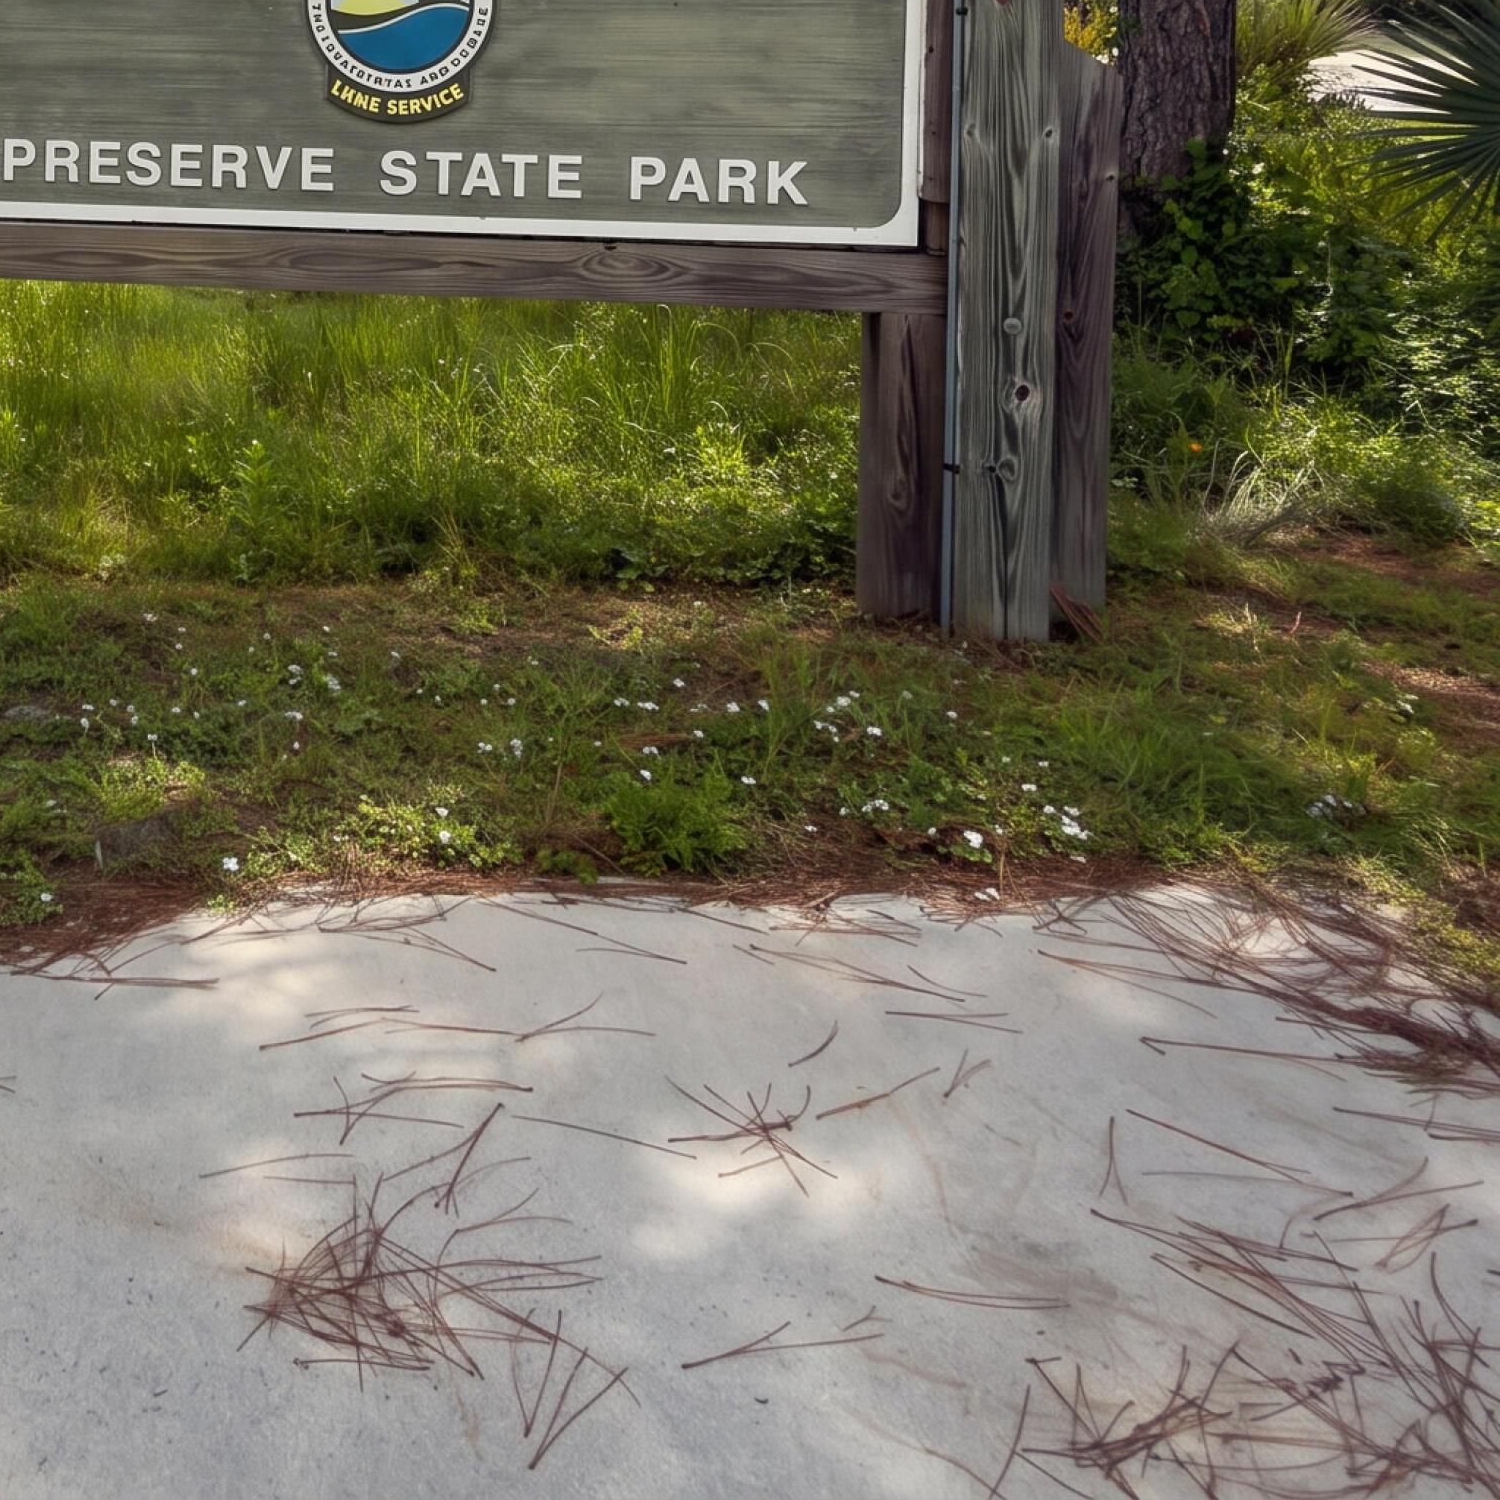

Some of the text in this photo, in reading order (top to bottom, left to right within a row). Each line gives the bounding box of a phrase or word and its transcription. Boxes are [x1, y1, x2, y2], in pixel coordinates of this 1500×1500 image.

[387, 83, 464, 115] SERVICE
[2, 137, 810, 207] PRESERVE STATE PARK
